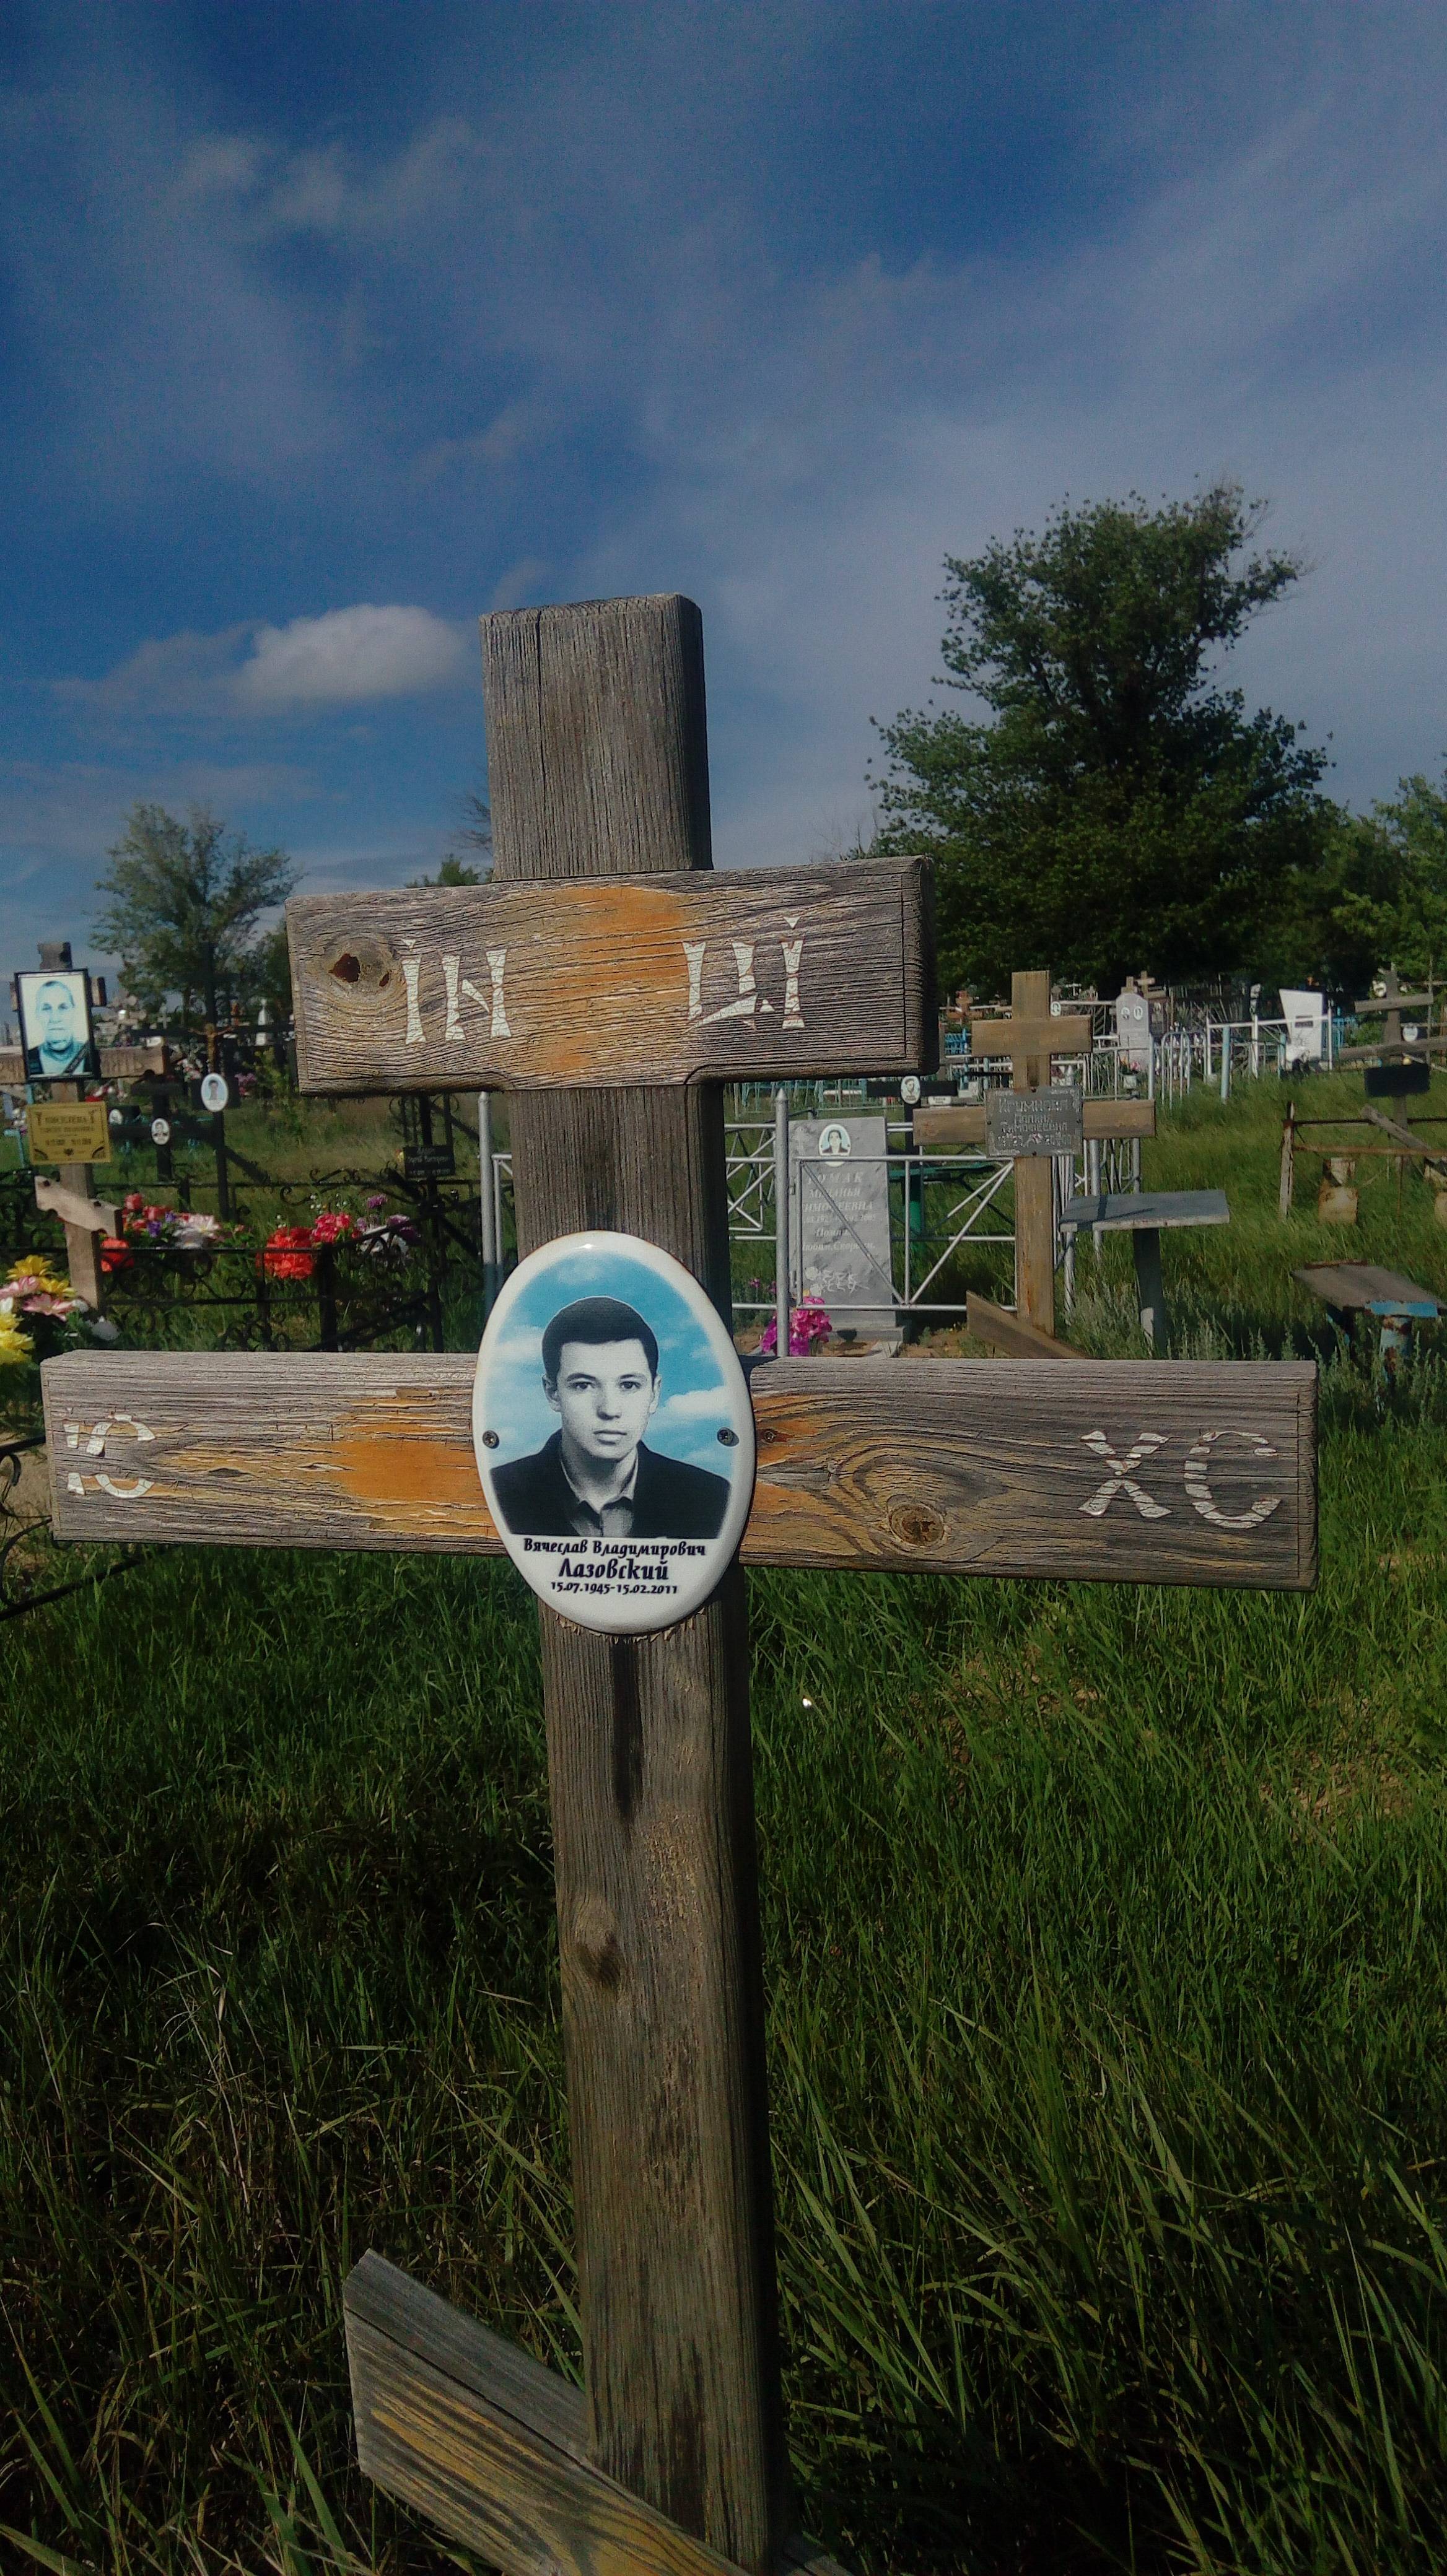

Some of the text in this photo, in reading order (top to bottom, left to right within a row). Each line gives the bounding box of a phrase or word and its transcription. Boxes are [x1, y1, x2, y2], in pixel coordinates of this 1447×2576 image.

[523, 1538, 706, 1559] Вячеслав Владимирович
[558, 1558, 669, 1580] Лазовский
